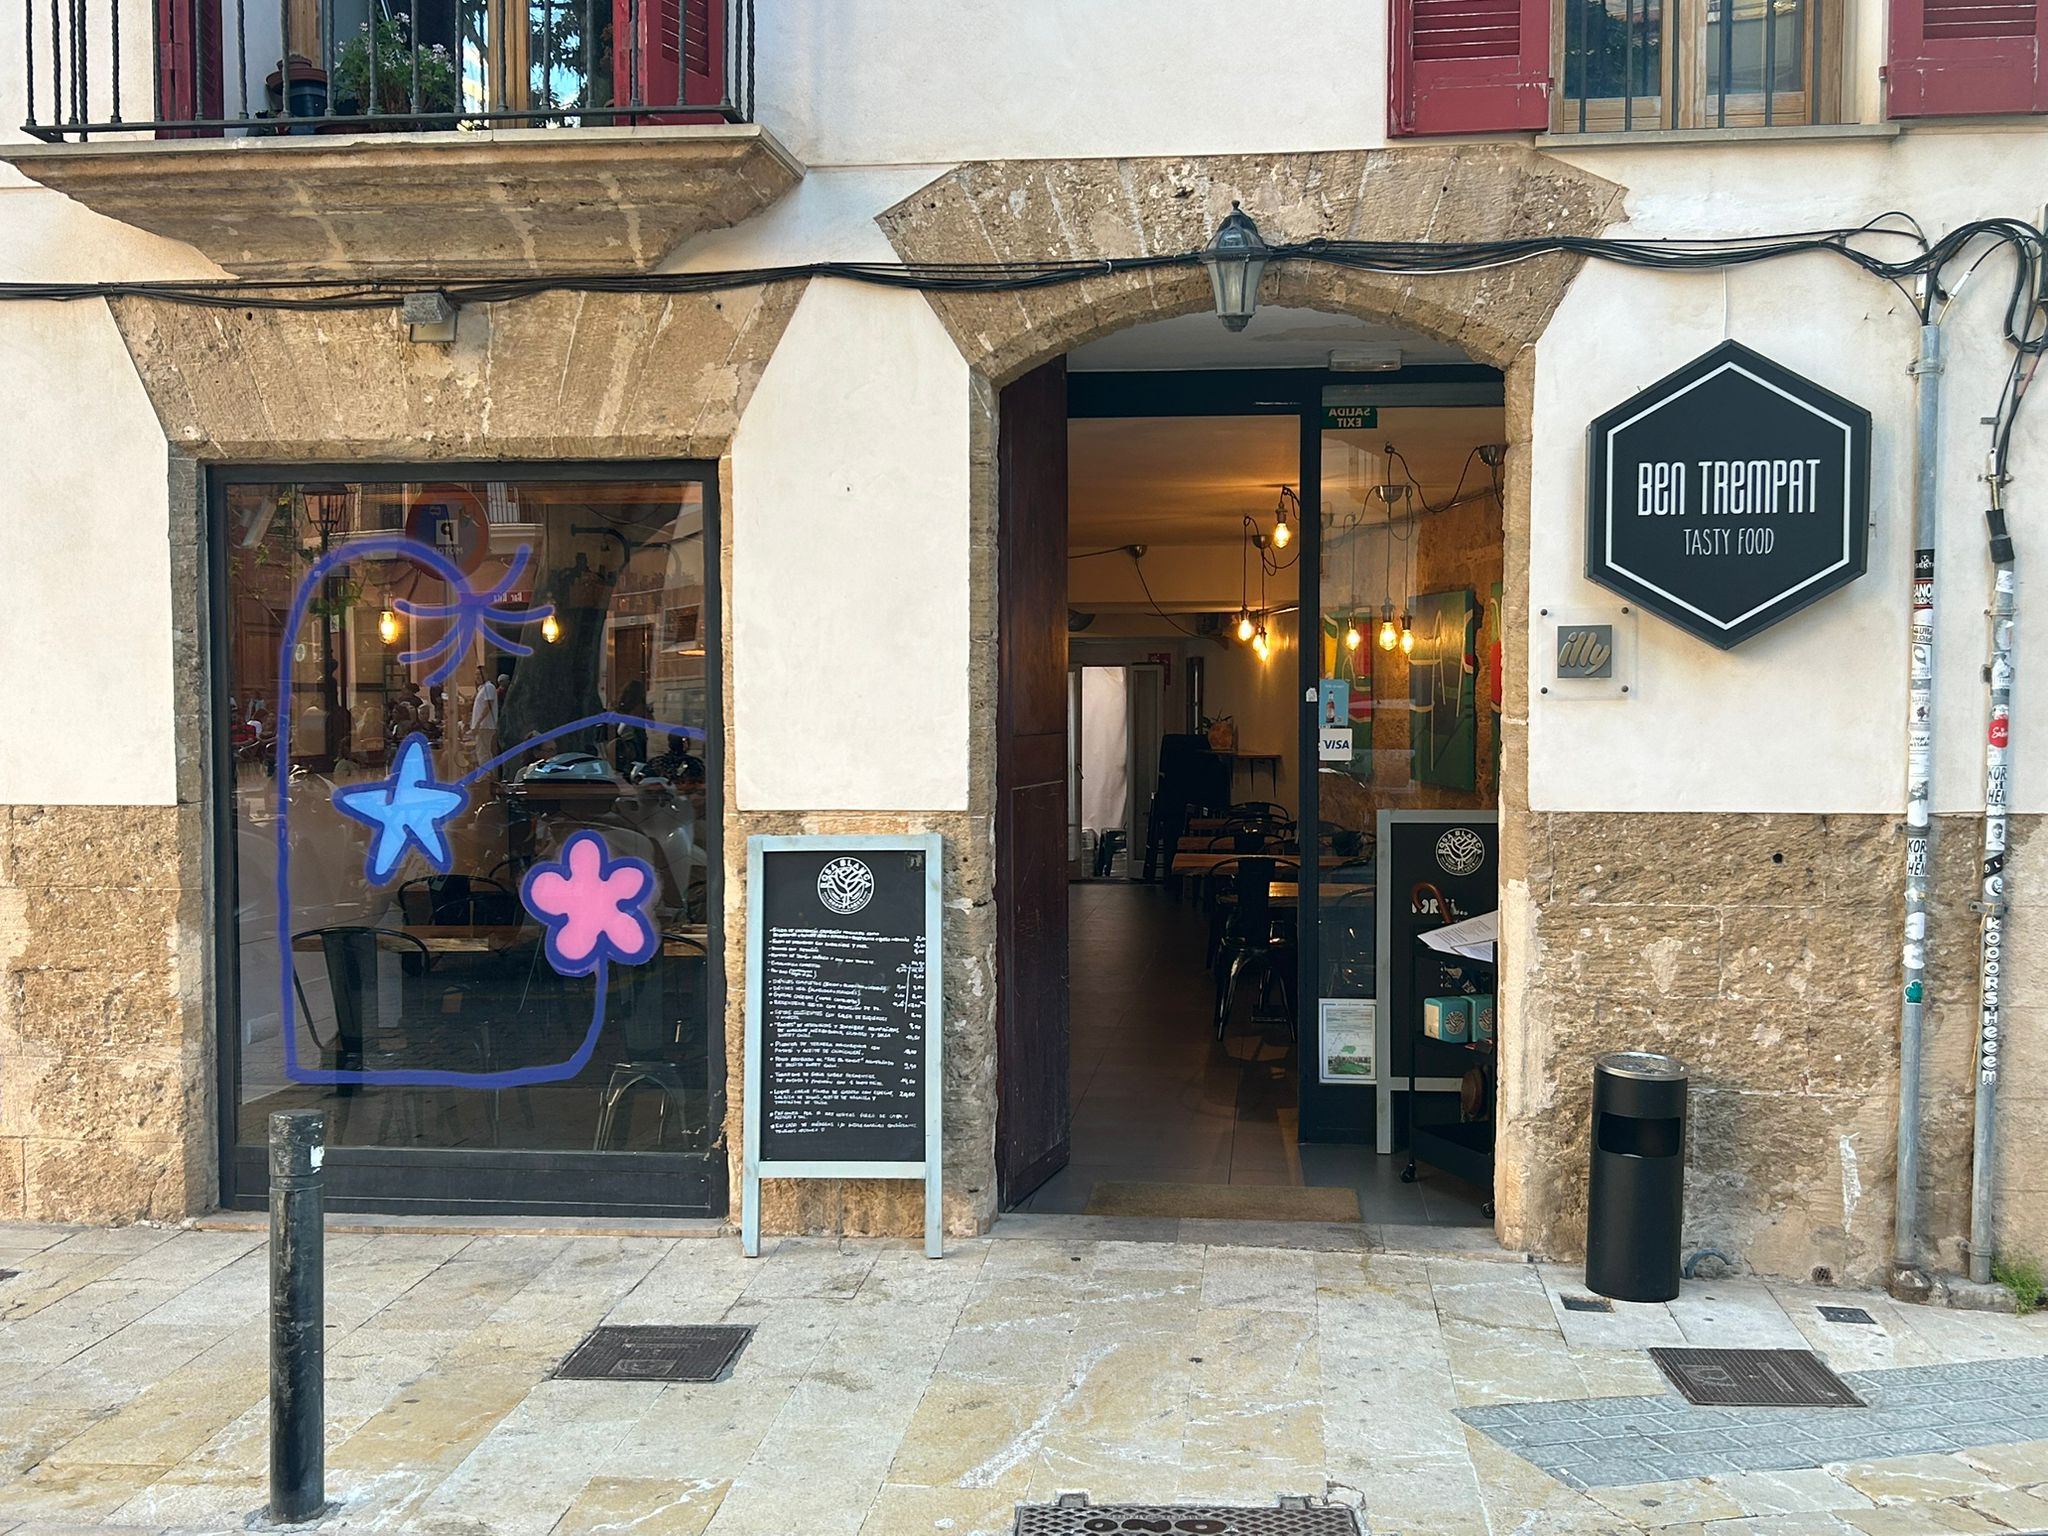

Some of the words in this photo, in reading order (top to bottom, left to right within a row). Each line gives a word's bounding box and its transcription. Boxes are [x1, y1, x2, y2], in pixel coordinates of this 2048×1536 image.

[1683, 528, 1729, 556] TASTY
[1737, 527, 1775, 555] FOOD
[1558, 631, 1611, 676] illy
[1322, 740, 1350, 750] VISA
[1438, 834, 1453, 854] ROSA
[1455, 830, 1482, 855] BLANCA
[839, 859, 872, 889] BLANCA
